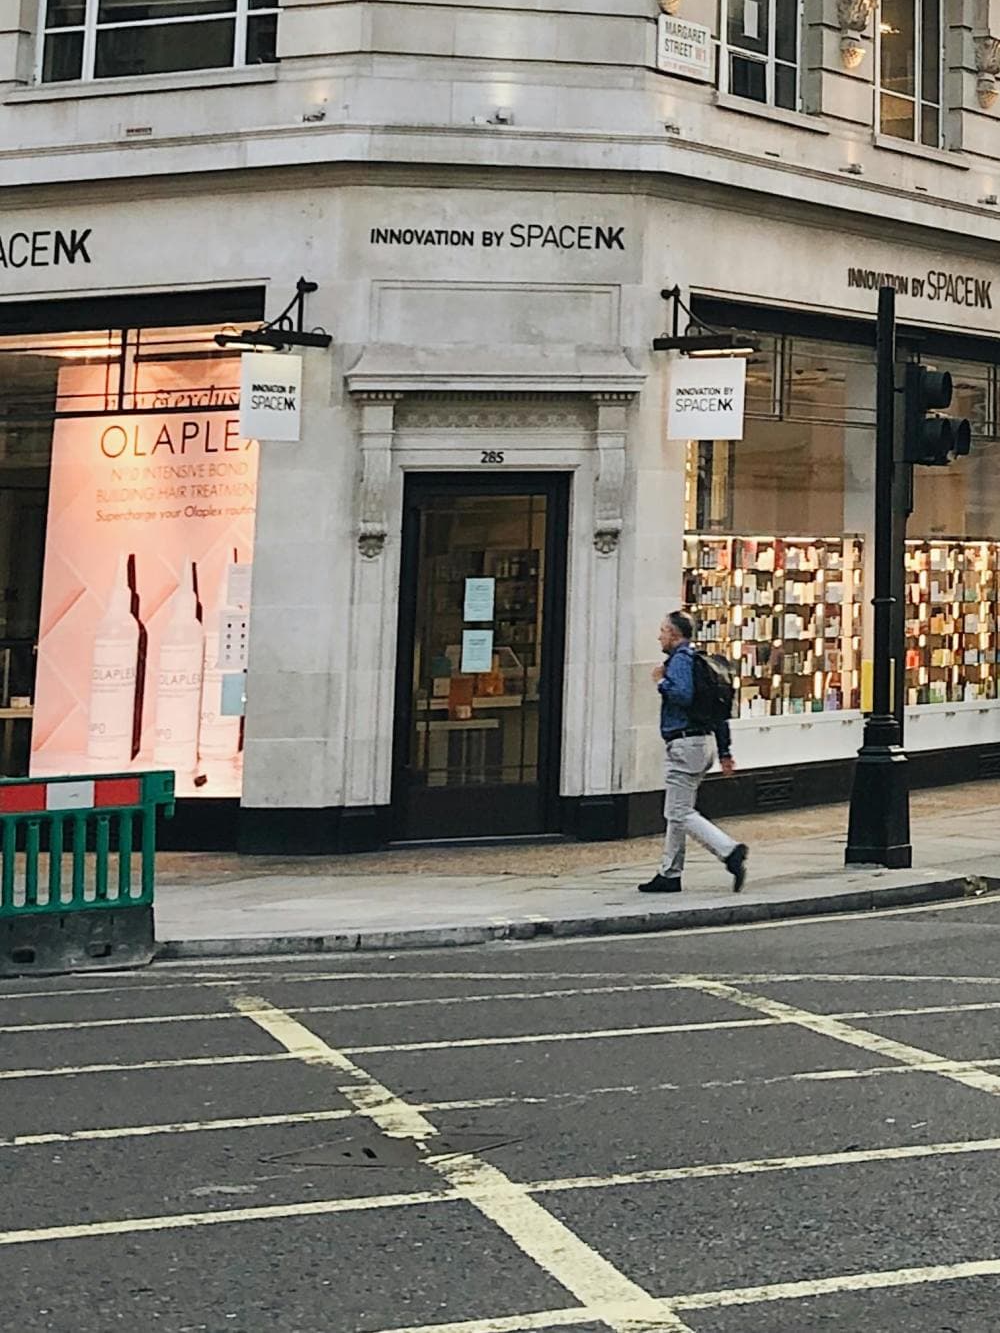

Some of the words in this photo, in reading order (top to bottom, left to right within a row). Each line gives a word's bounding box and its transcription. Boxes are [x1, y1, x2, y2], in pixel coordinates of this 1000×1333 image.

[665, 38, 692, 58] STREET
[370, 228, 474, 246] INNOVATION
[481, 231, 503, 247] BY
[848, 267, 908, 295] INNOVATION
[911, 277, 925, 297] BY
[174, 386, 240, 408] exclus
[676, 387, 721, 395] INNOVATION
[101, 419, 253, 458] OLAPLE
[190, 482, 256, 499] TREATMEN
